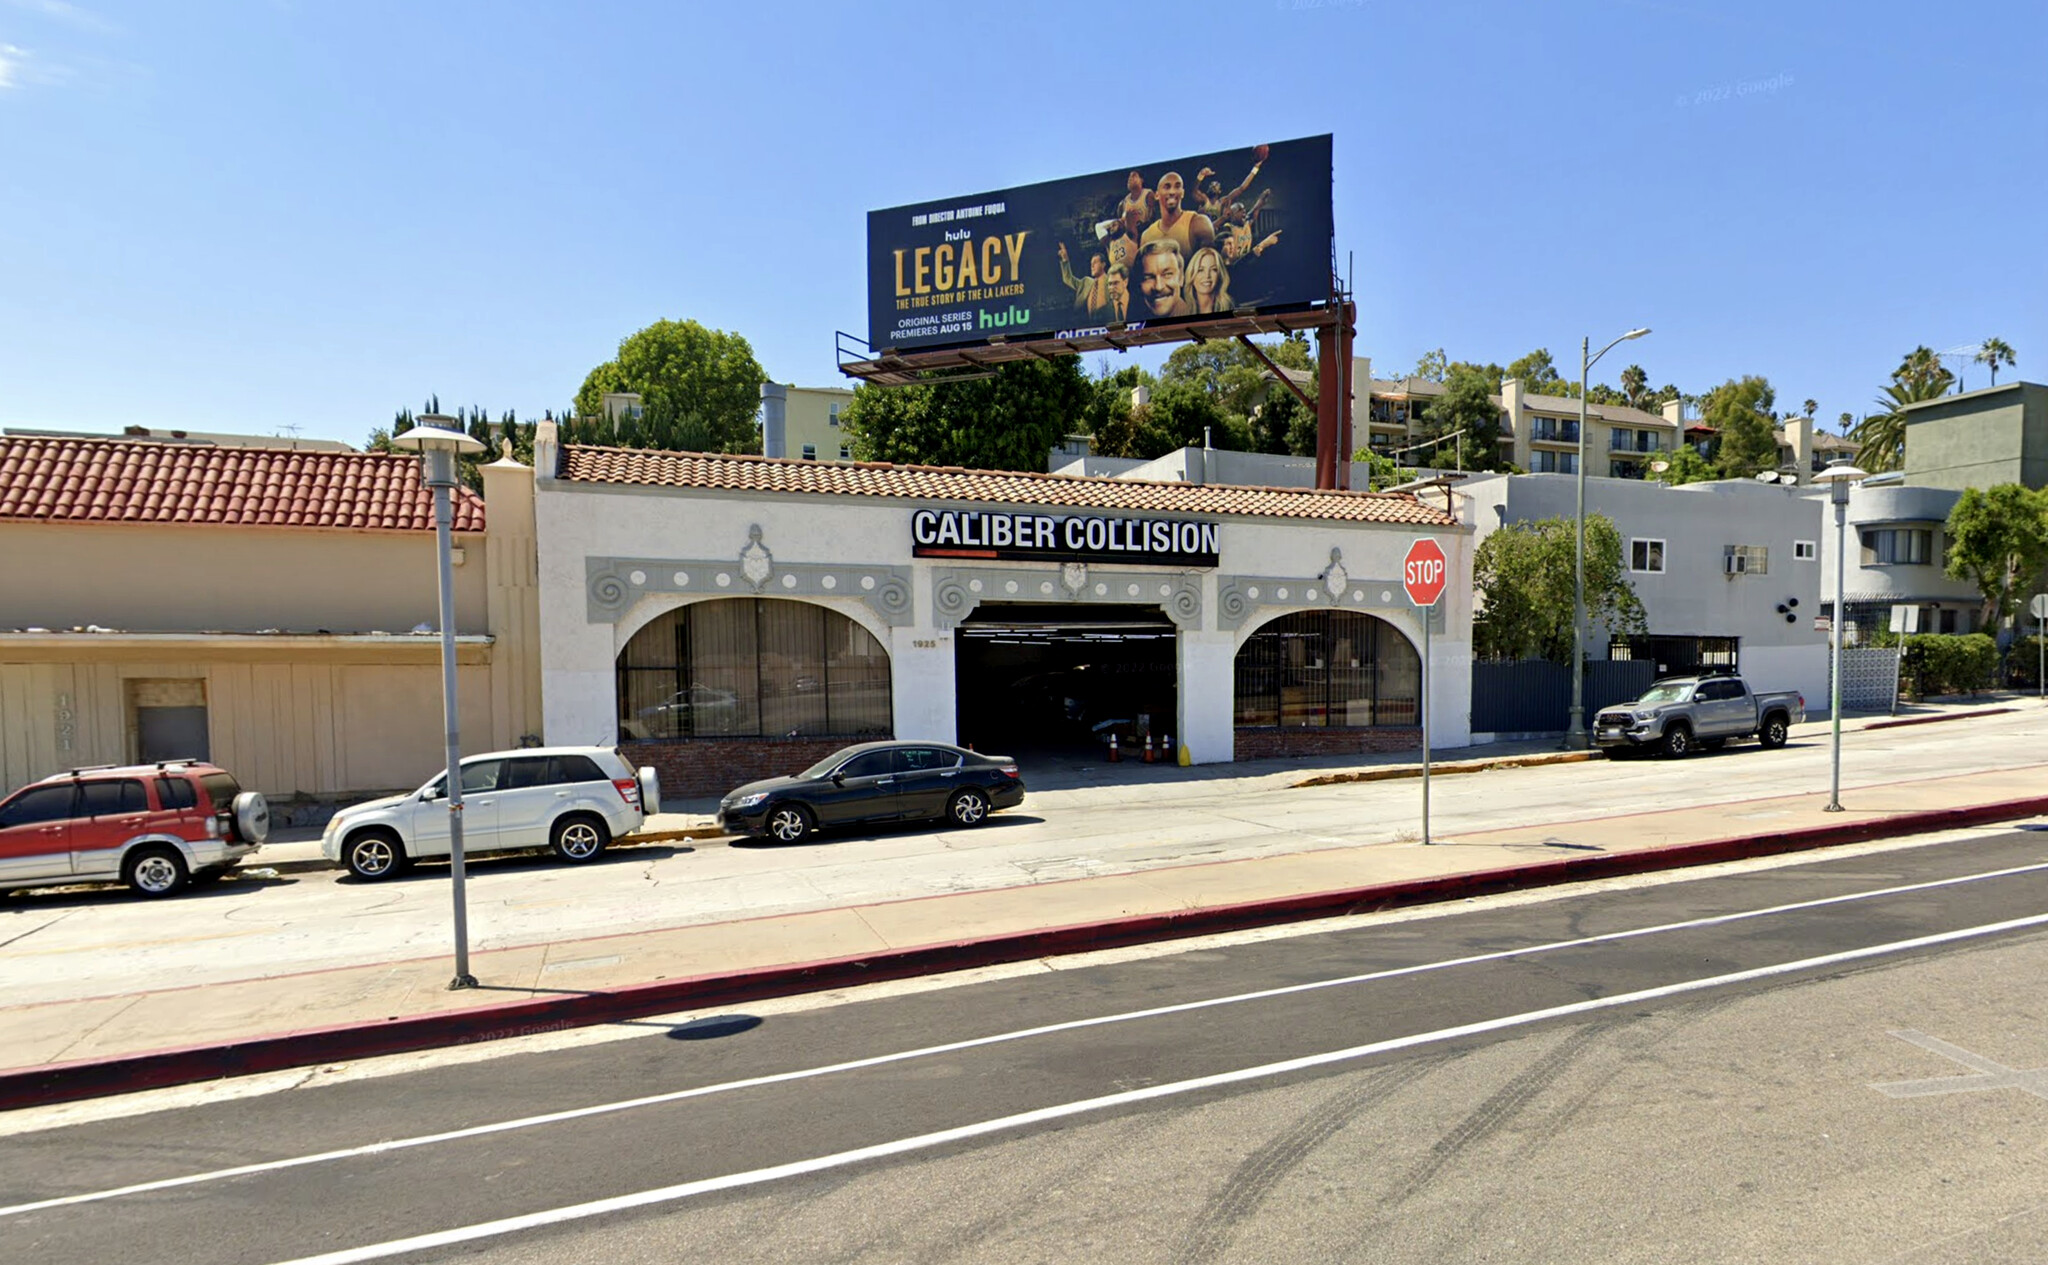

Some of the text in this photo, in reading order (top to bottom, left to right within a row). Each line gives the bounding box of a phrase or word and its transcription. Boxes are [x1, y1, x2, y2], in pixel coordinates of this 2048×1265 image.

[912, 202, 1006, 227] FROM DIRECTOR ANTOINE FUQUA
[945, 228, 971, 241] hulu
[893, 231, 1026, 297] LEGACY
[896, 283, 1025, 311] THE TRUE STORY OF THE LA LAKERS
[898, 311, 973, 328] ORIGINAL SERIES
[979, 305, 1030, 329] hulu
[890, 322, 973, 339] PREMIERES AUG 15
[915, 511, 1220, 554] CALIBER COLLISION
[1406, 559, 1443, 585] STOP
[912, 640, 936, 648] 1925
